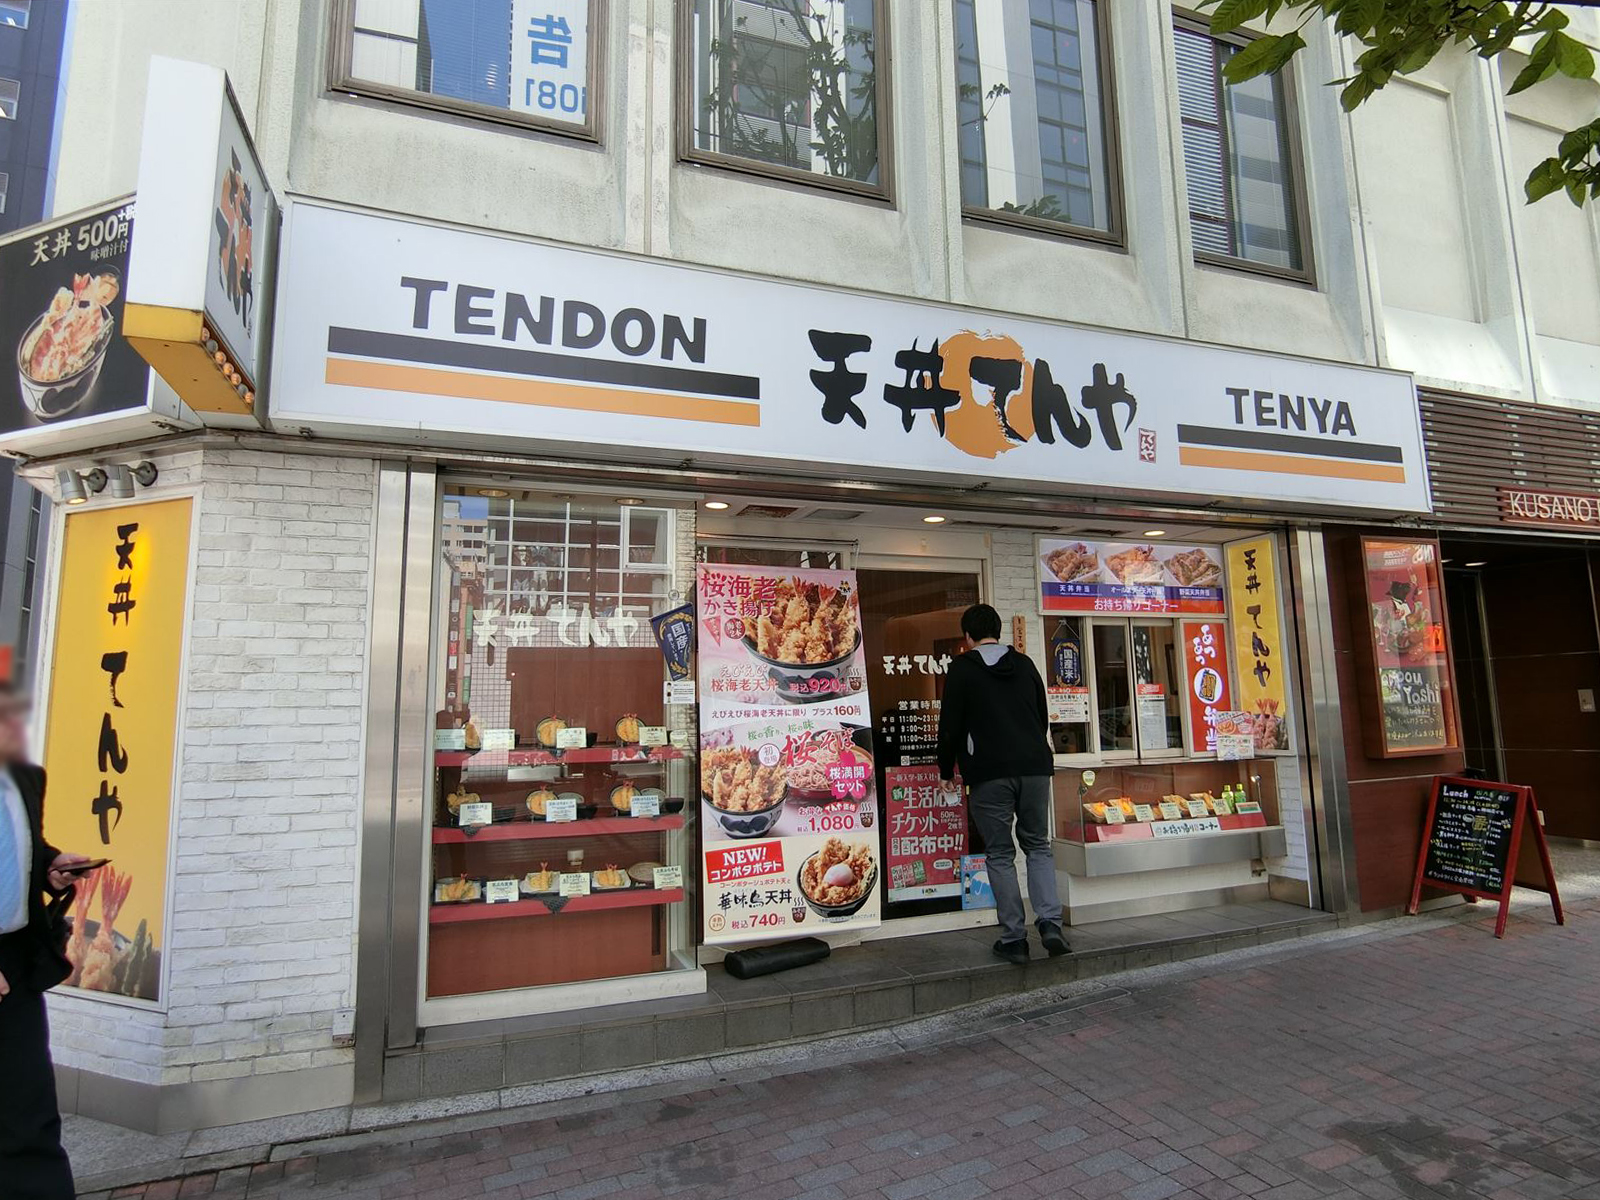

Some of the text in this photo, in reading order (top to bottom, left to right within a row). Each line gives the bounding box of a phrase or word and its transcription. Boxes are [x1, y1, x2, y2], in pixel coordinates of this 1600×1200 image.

[30, 228, 72, 267] 天丼
[400, 276, 707, 364] TENDON
[1225, 386, 1357, 436] TENYA
[1509, 491, 1592, 522] KUSANO
[700, 572, 777, 600] 桜海老
[703, 600, 776, 618] かき揚げ
[711, 678, 778, 693] 桜海老天丼
[898, 700, 942, 711] 営業時間
[829, 766, 866, 780] 桜満開
[835, 780, 863, 793] セット
[891, 811, 940, 834] チケット
[723, 847, 767, 866] NEW!
[710, 862, 782, 881] コンポタポテト
